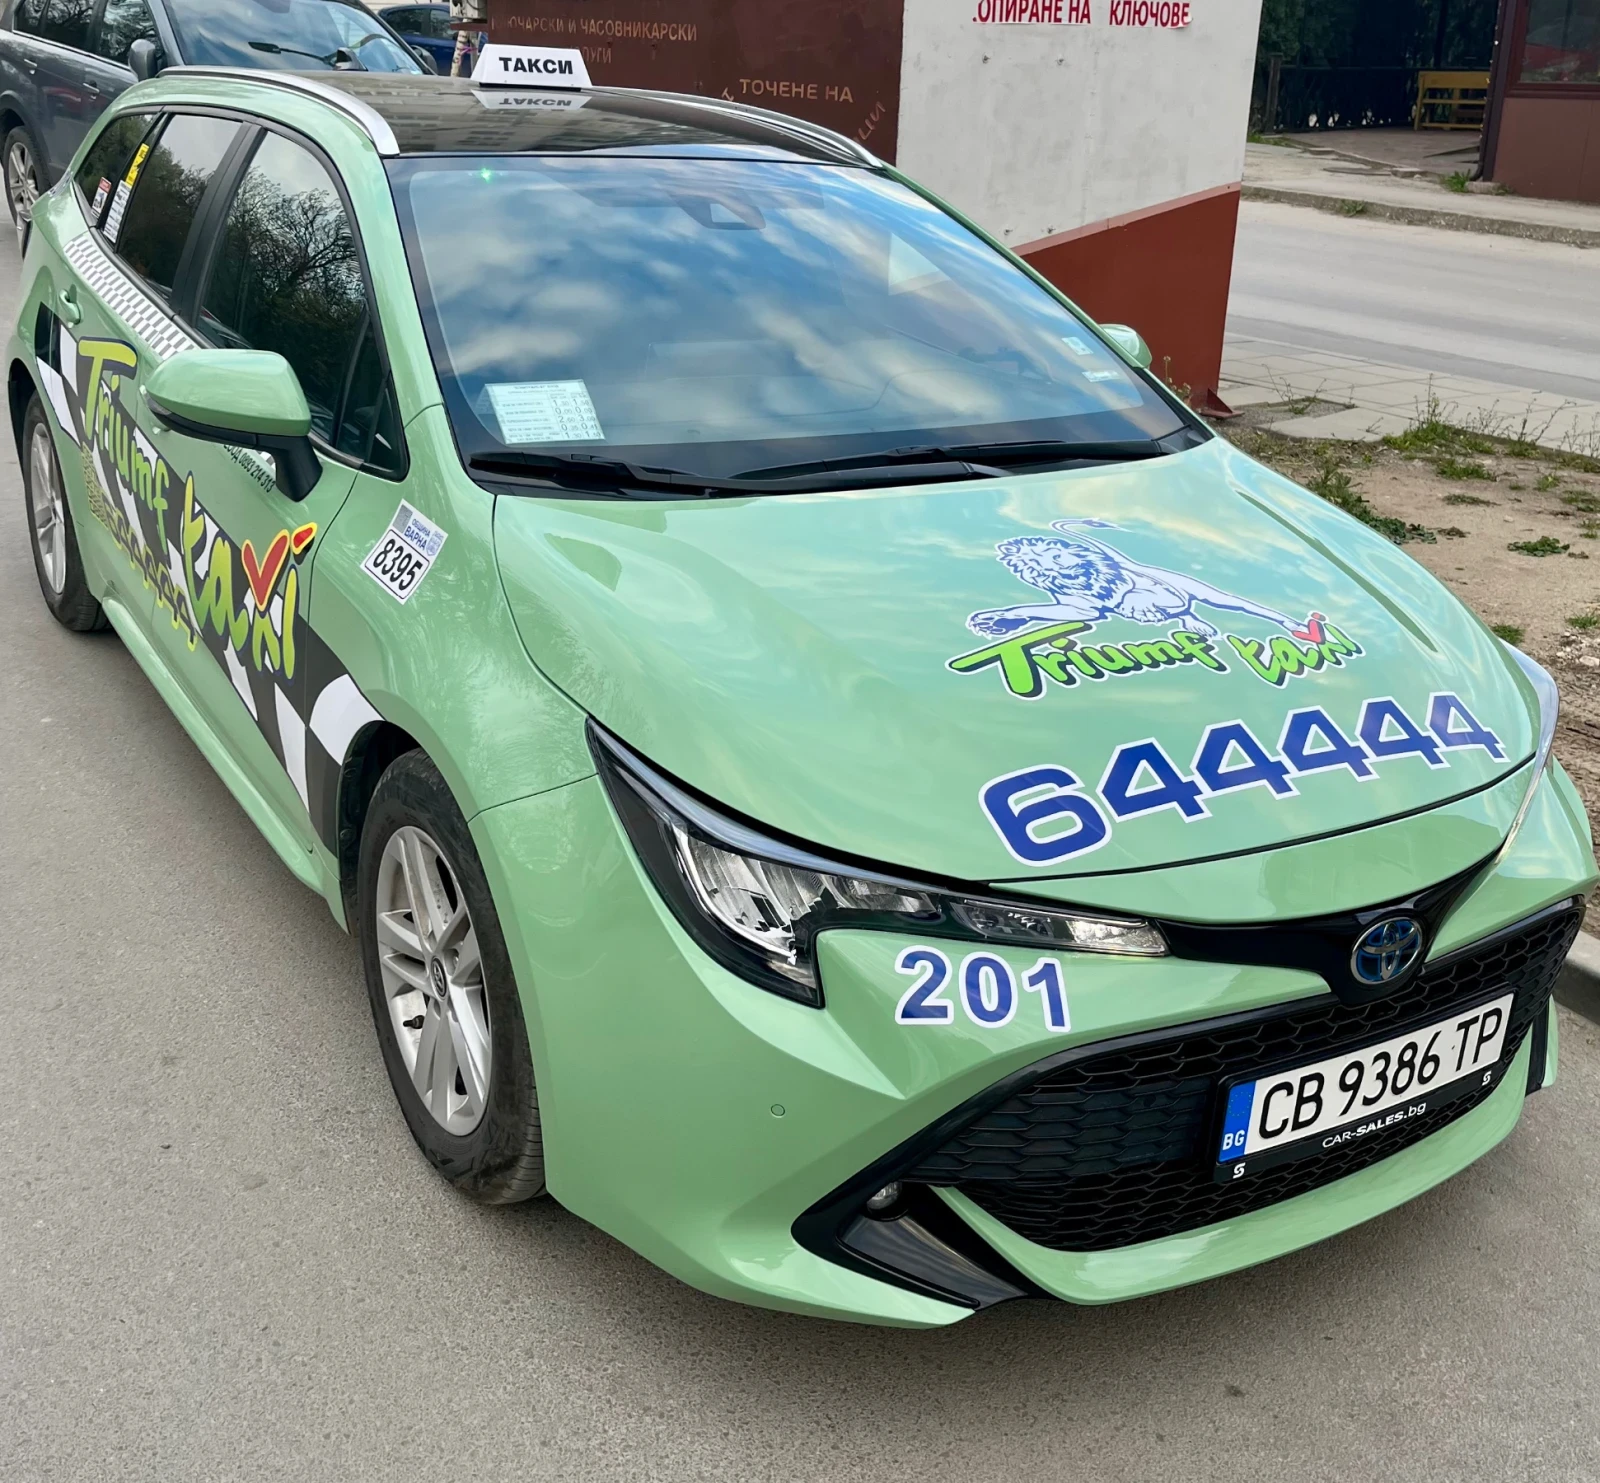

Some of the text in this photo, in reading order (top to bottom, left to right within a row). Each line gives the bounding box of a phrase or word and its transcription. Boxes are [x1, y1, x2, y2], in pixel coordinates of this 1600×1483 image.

[491, 15, 698, 41] ЮЧАРСКИ И ЧАСОВНИКАРСКИ
[973, 0, 1190, 27] ОПИРАНЕ НА КЛЮЧОВЕ
[499, 57, 573, 74] ТАКСИ
[740, 79, 818, 99] ТОЧЕНЕ
[825, 85, 853, 103] НА
[78, 336, 169, 555] Triumf
[250, 464, 266, 482] 214
[260, 474, 276, 493] 313
[404, 526, 427, 550] ВАРНА
[373, 538, 423, 591] 8395
[946, 620, 1230, 698] Triumf
[981, 693, 1507, 865] 644444
[898, 948, 1068, 1030] 201
[1223, 1007, 1503, 1151] BG CB 9386 TP
[1322, 1102, 1427, 1148] CAR-SALES.bg
